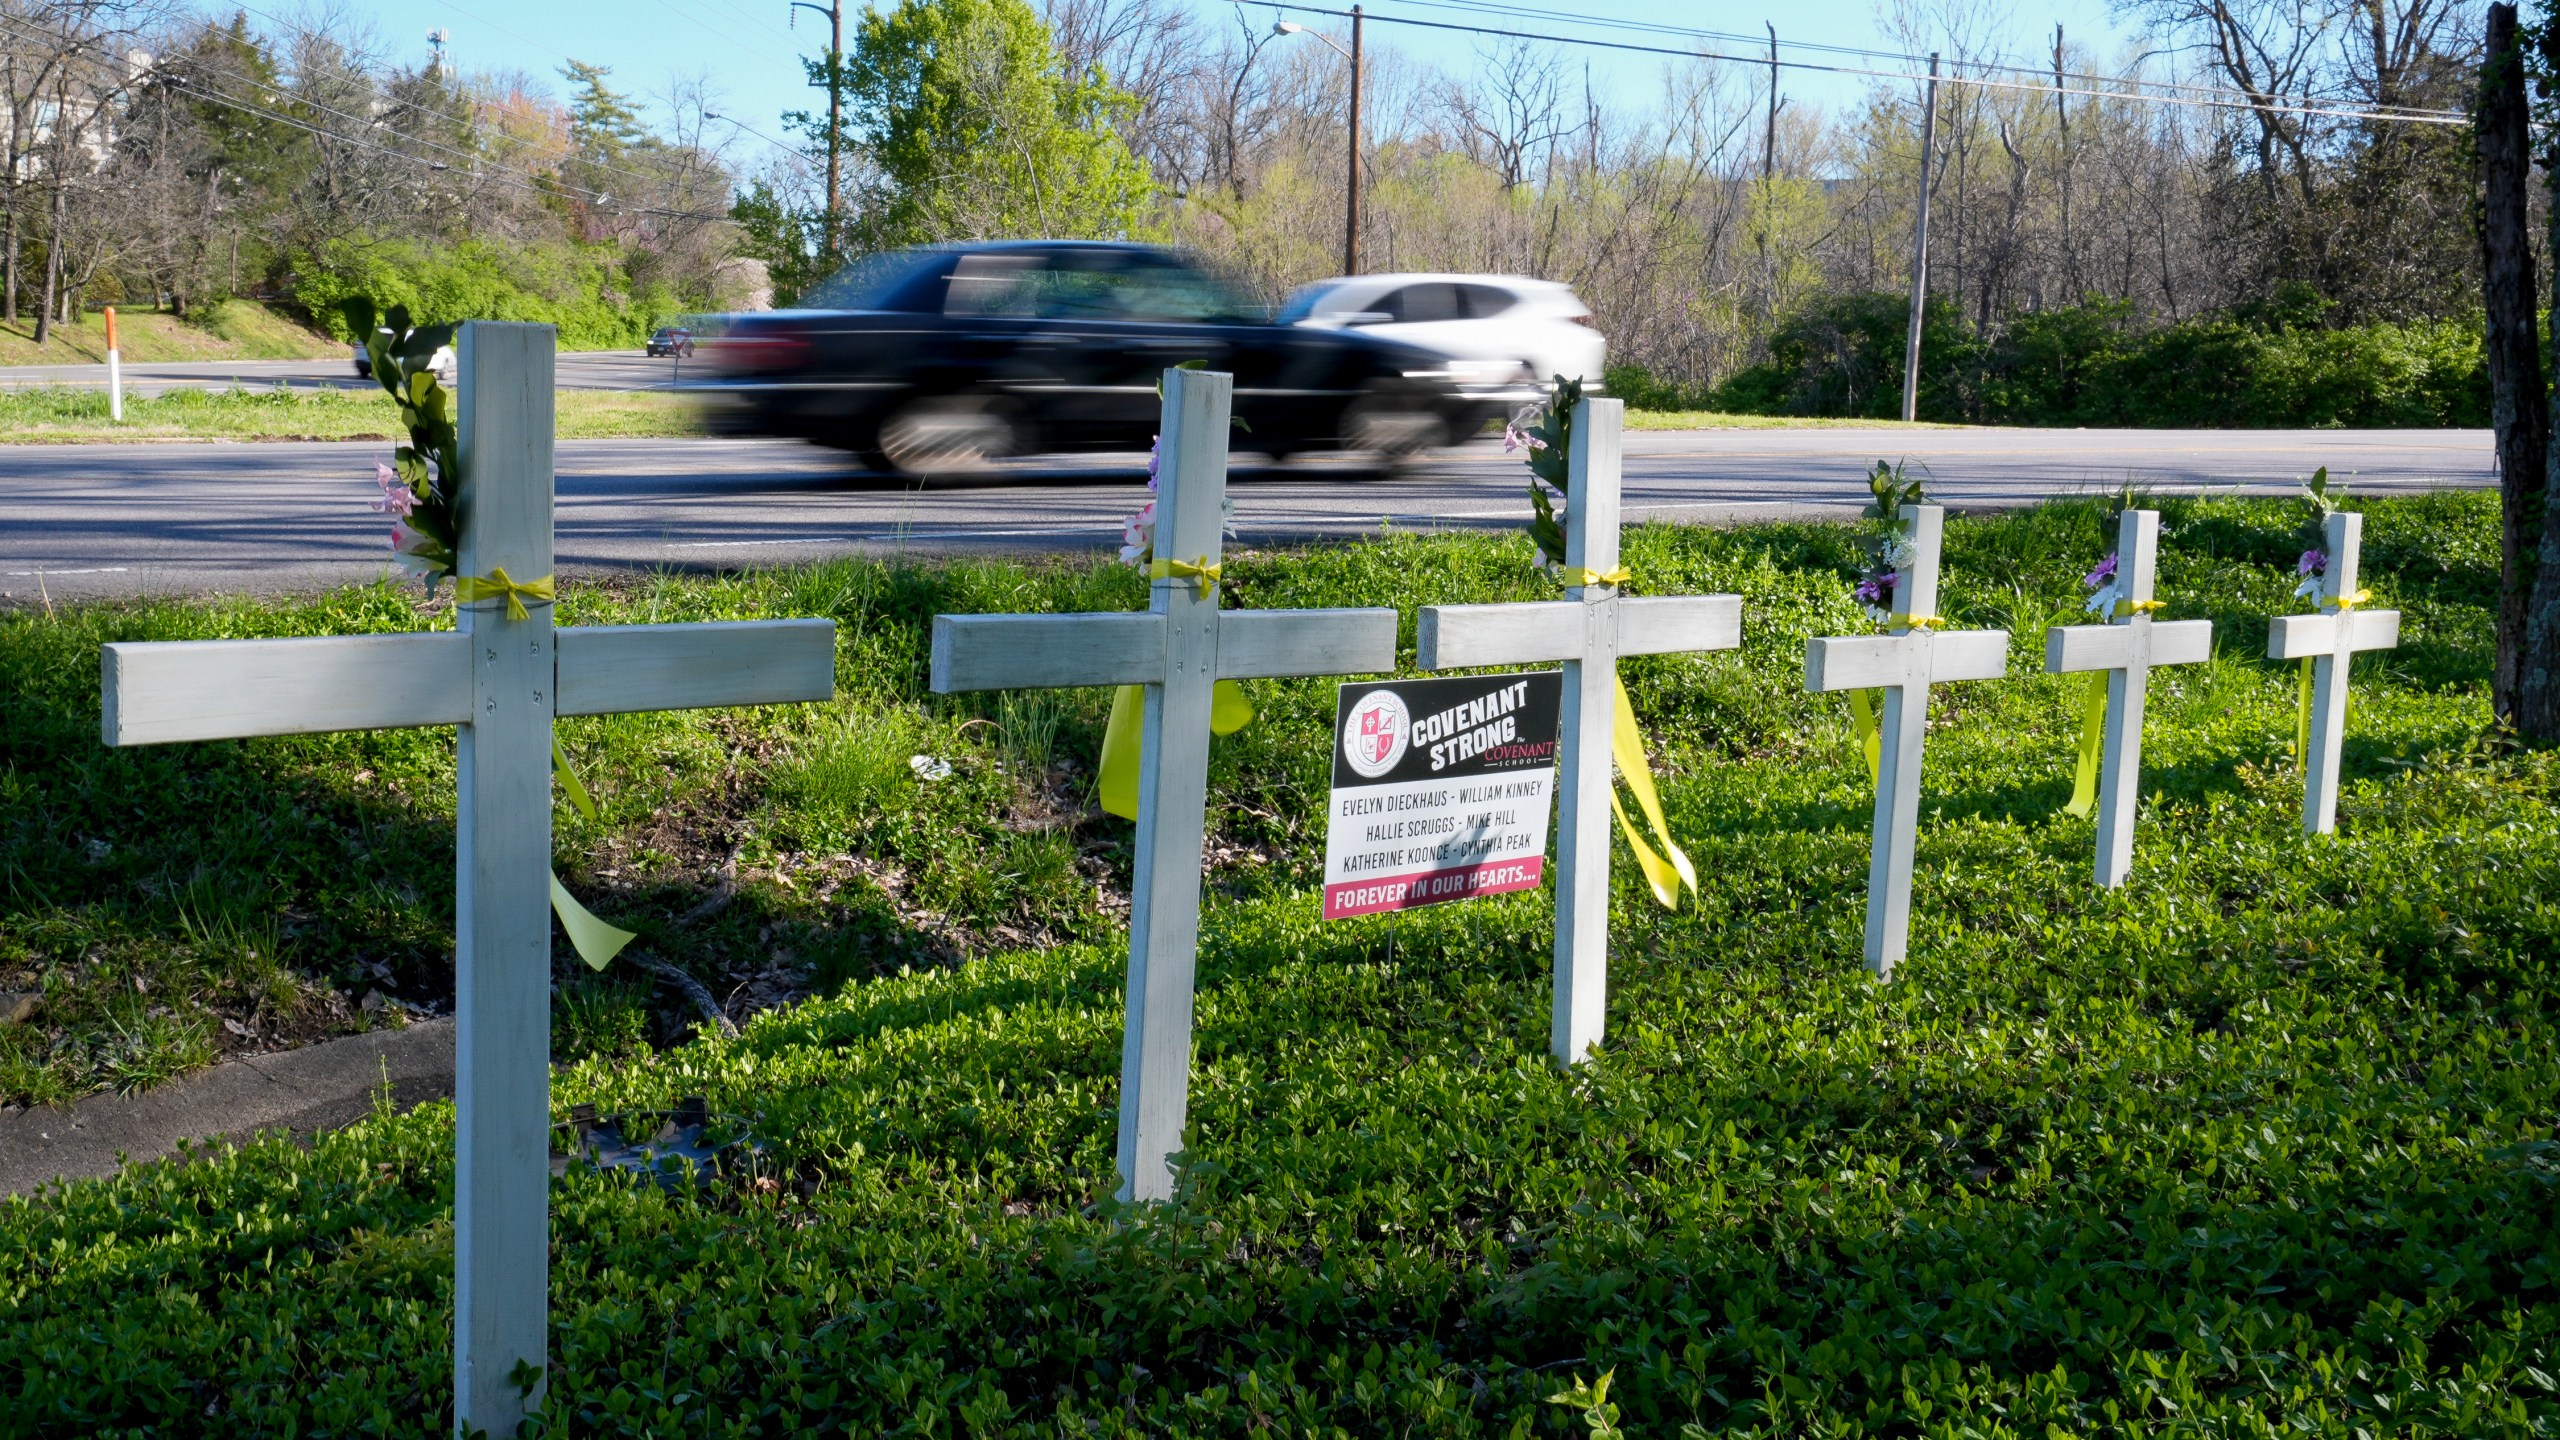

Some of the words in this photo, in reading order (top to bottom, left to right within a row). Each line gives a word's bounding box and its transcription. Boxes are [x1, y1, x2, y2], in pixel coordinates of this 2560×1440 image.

[1411, 680, 1528, 748] COVENANT
[1430, 715, 1516, 772] STRONG
[1484, 741, 1554, 761] COVENANT
[1499, 757, 1537, 767] SCHOOL
[1342, 796, 1383, 817] EVELYN
[1387, 790, 1448, 812] DIECKHAUS
[1459, 784, 1501, 804] WILLIAM
[1506, 780, 1543, 798] KINNEY
[1366, 822, 1403, 842] HALLIE
[1407, 816, 1455, 837] SCRUGGS
[1466, 812, 1491, 830] MIKE
[1495, 809, 1516, 826] HILL
[1343, 850, 1403, 873] KATHERINE
[1407, 844, 1449, 864] KOONCE
[1460, 837, 1502, 857] CYNTHIA
[1506, 833, 1532, 850] PEAK
[1335, 882, 1407, 910] FOREVER
[1411, 879, 1428, 897] IN
[1432, 874, 1463, 895] OUR
[1467, 866, 1537, 890] HEARTS...
